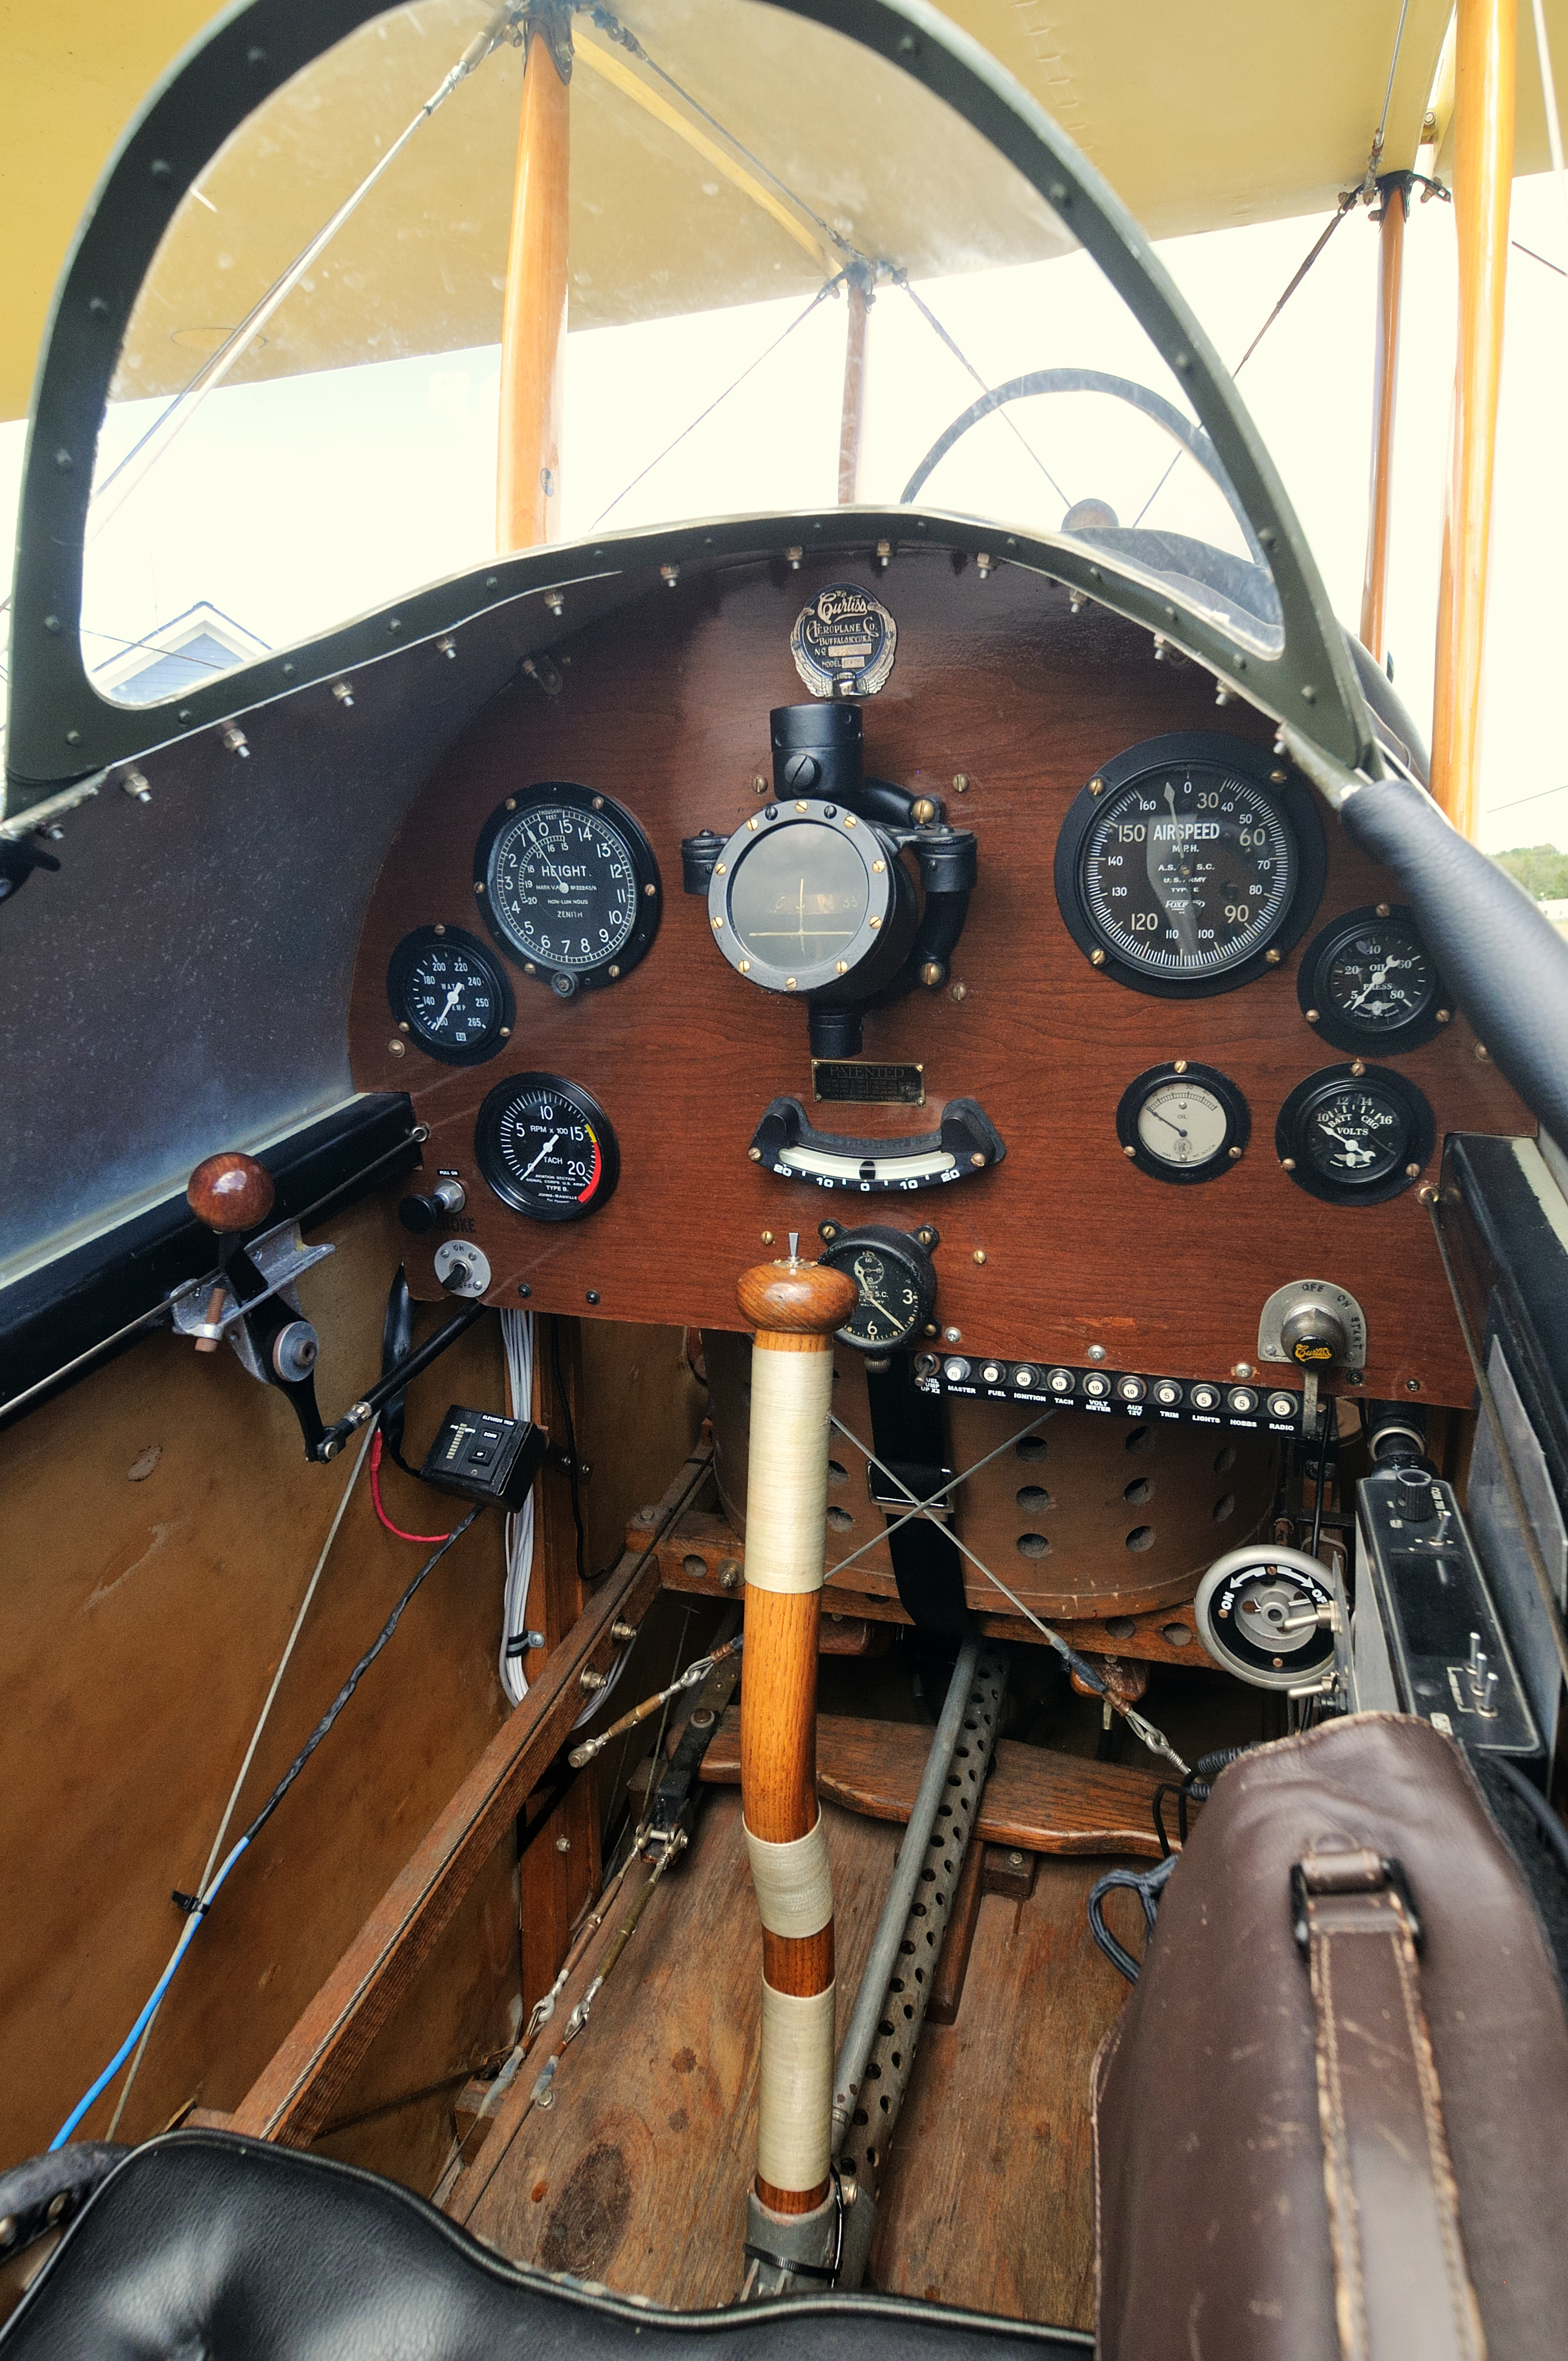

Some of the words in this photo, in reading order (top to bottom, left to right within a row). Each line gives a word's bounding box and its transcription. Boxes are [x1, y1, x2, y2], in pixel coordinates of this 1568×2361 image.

[818, 592, 868, 624] Curtiss
[806, 621, 861, 644] AEROPLANE
[1184, 782, 1191, 793] 0
[1140, 801, 1157, 810] 160
[1196, 792, 1219, 809] 30
[1221, 802, 1234, 812] 40
[1239, 814, 1253, 824] 50
[539, 823, 548, 836] 0
[559, 819, 573, 834] 15
[1118, 824, 1145, 842] 150
[1153, 823, 1219, 841] AIRSPEED
[521, 833, 526, 846] 1
[578, 827, 592, 842] 14
[1239, 829, 1266, 846] 60
[547, 844, 555, 853] 16
[597, 843, 611, 858] 13
[508, 853, 518, 867] 2
[1108, 856, 1123, 866] 140
[1257, 860, 1271, 870] 70
[610, 864, 623, 879] 12
[504, 876, 513, 890] 3
[617, 889, 625, 903] 11
[1112, 887, 1128, 897] 130
[1249, 885, 1262, 895] 80
[511, 900, 520, 913] 4
[609, 911, 622, 924] 10
[1224, 905, 1249, 923] 90
[524, 921, 534, 934] 5
[1131, 913, 1158, 931] 120
[599, 928, 609, 943] 9
[1166, 929, 1179, 939] 110
[1198, 929, 1215, 939] 100
[541, 935, 551, 949] 6
[562, 940, 570, 954] 7
[581, 938, 590, 953] 8
[1366, 945, 1381, 954] 40
[433, 963, 446, 971] 200
[454, 963, 467, 971] 220
[1345, 966, 1359, 975] 20
[1398, 960, 1412, 969] 60
[424, 976, 435, 984] 180
[468, 977, 481, 986] 240
[1351, 991, 1358, 999] 5
[1390, 991, 1404, 999] 80
[423, 997, 435, 1005] 140
[475, 998, 489, 1007] 250
[468, 1018, 481, 1027] 265
[830, 1066, 904, 1078] PATENTED
[1360, 1097, 1373, 1106] 14
[540, 1106, 553, 1120] 10
[1316, 1113, 1329, 1122] 10
[1327, 1114, 1352, 1128] BATT
[1361, 1116, 1380, 1130] CHG
[1380, 1116, 1392, 1124] 16
[516, 1123, 525, 1137] 5
[570, 1127, 584, 1141] 15
[567, 1161, 585, 1176] 20
[773, 1164, 792, 1177] 20
[816, 1177, 834, 1188] 10
[861, 1183, 870, 1192] 0
[900, 1179, 918, 1189] 10
[941, 1169, 960, 1183] 20
[903, 1289, 913, 1304] 3
[1337, 1294, 1352, 1309] ON
[867, 1320, 878, 1335] 6
[1351, 1317, 1363, 1350] START
[1295, 1344, 1332, 1362] Curtiss
[948, 1385, 976, 1394] MASTER
[1014, 1393, 1046, 1402] IGNITION
[1086, 1404, 1111, 1413] METER
[1160, 1411, 1179, 1419] TRIM
[1193, 1415, 1221, 1423] LIGHTS
[1230, 1419, 1257, 1428] HOBBS
[1221, 1591, 1235, 1610] ON
[1312, 1588, 1330, 1604] OF
